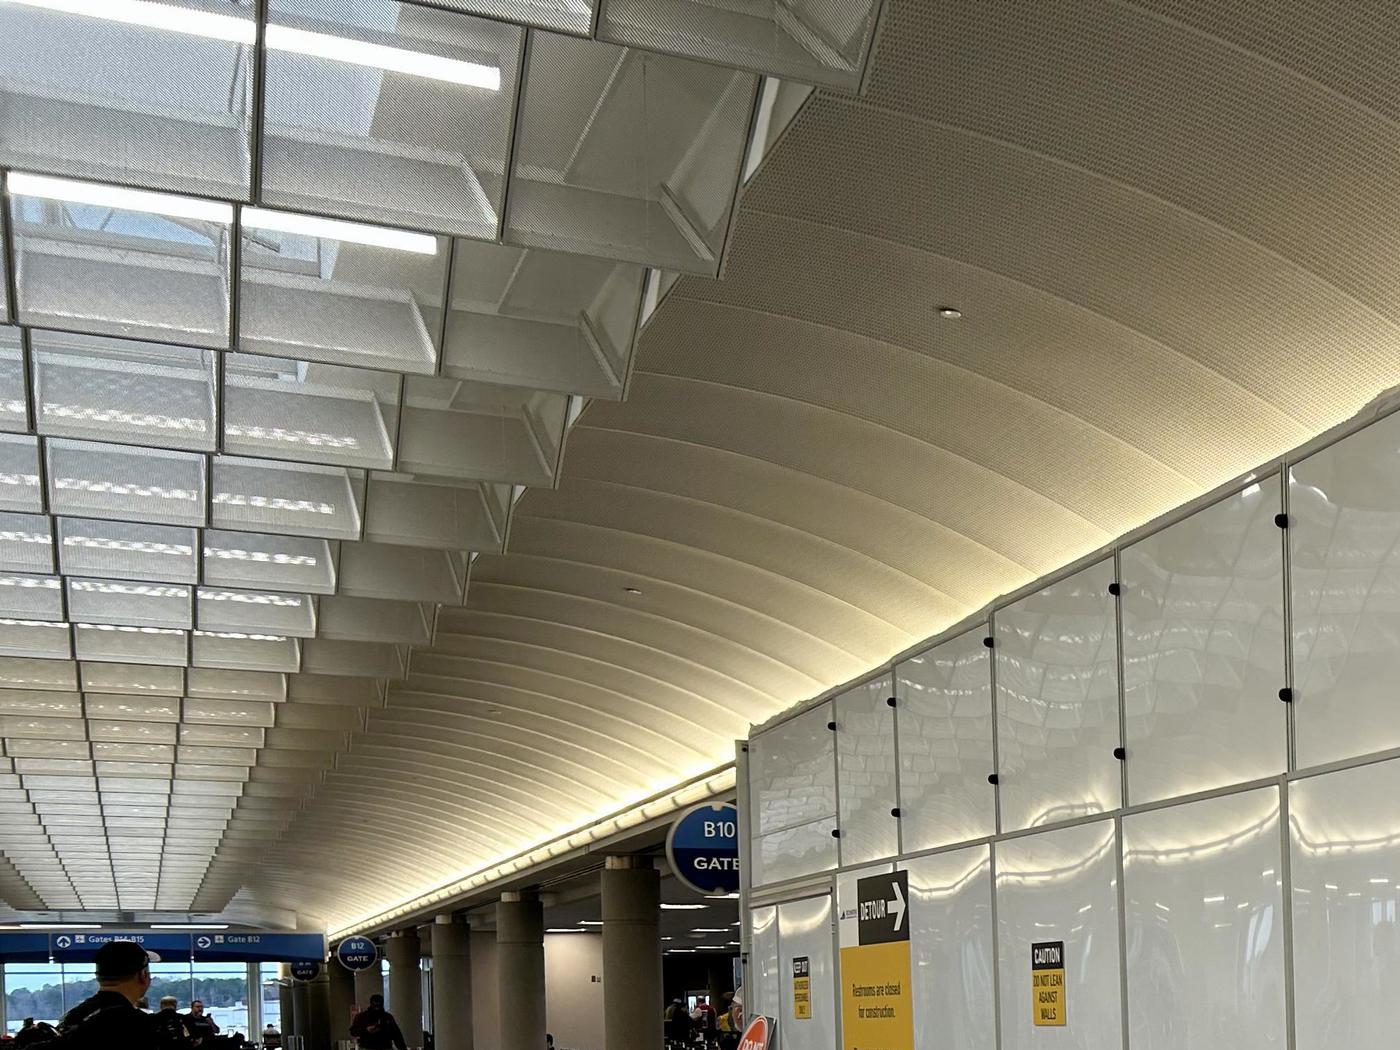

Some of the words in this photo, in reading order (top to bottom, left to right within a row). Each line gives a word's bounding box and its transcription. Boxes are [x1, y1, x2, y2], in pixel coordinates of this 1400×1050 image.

[704, 821, 735, 838] B10
[694, 857, 741, 871] GATE
[860, 900, 886, 920] DETOUR
[88, 935, 112, 944] Gates
[228, 936, 246, 944] Gate
[248, 935, 260, 944] B12
[351, 942, 365, 950] B12
[1034, 947, 1060, 964] CAUTION
[1050, 974, 1062, 987] LEAN
[853, 984, 876, 997] Restrooms
[876, 985, 884, 996] are
[885, 981, 901, 995] closed
[1039, 991, 1057, 1003] AGAINST
[1041, 1008, 1056, 1020] WALLS
